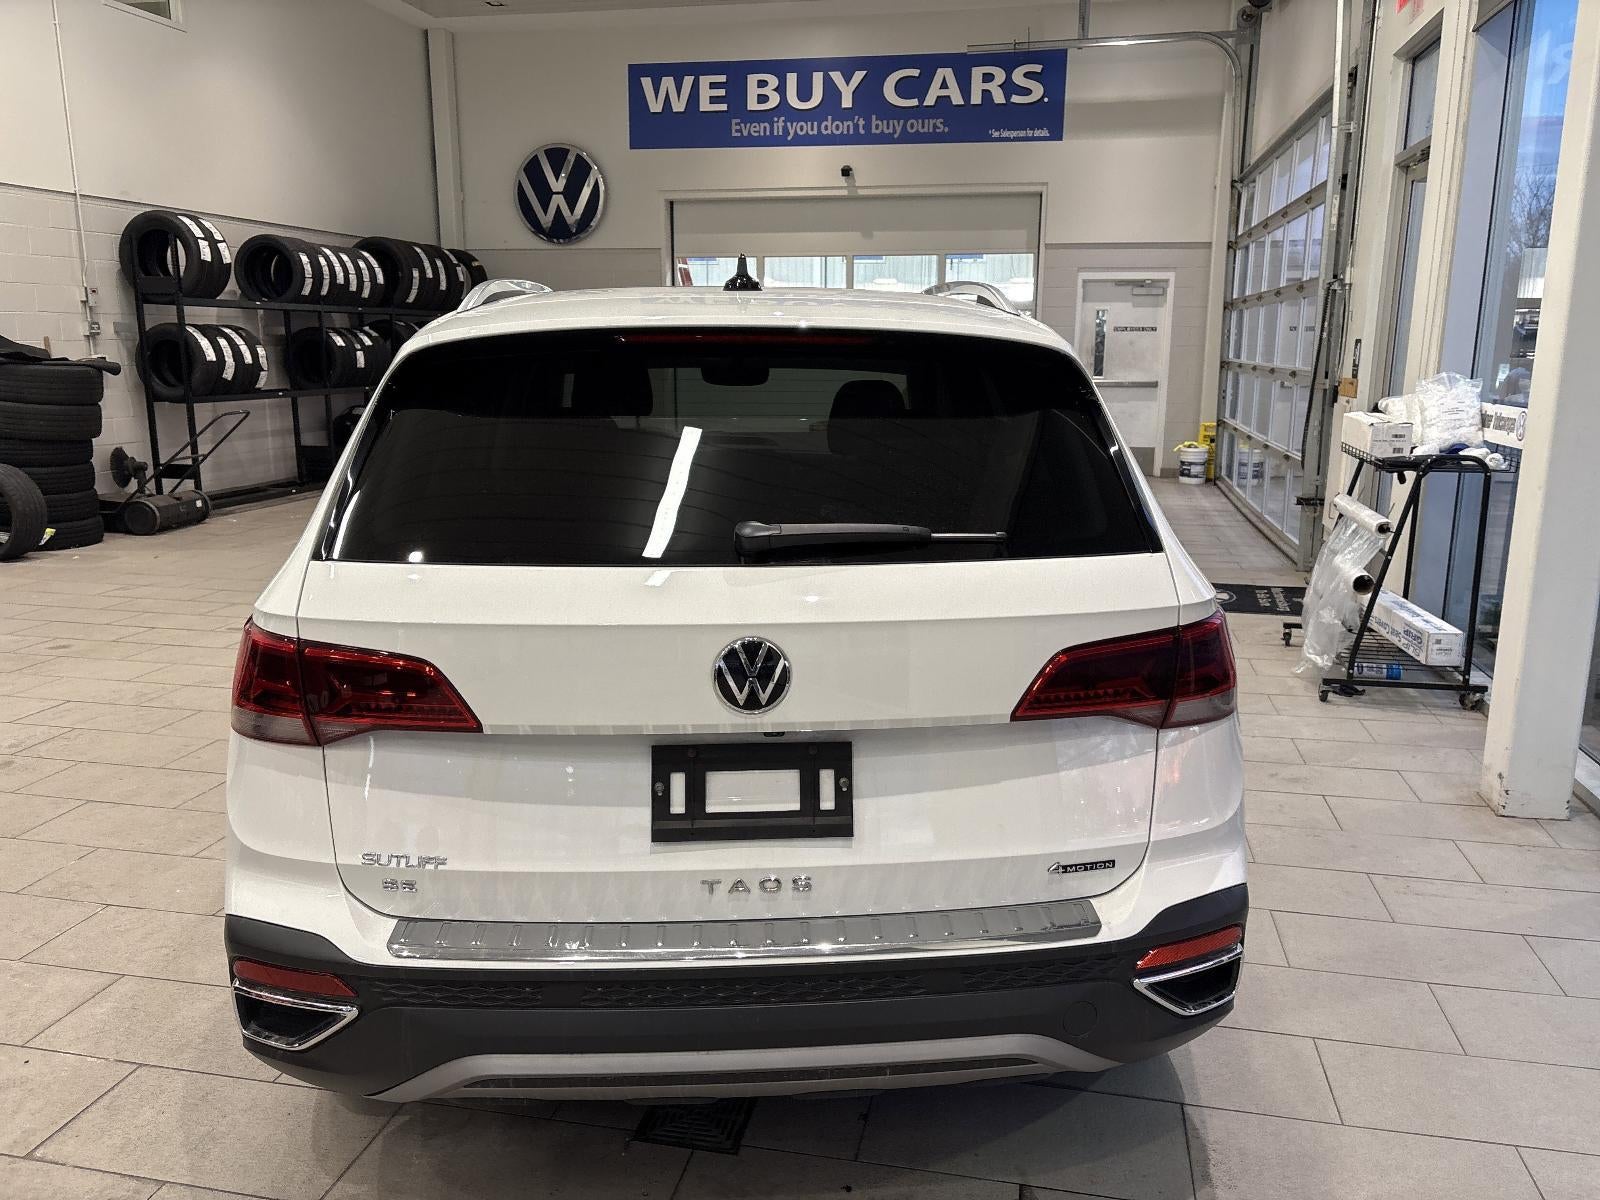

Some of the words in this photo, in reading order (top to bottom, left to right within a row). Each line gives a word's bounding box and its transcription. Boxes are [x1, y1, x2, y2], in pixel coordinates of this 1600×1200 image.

[640, 74, 729, 114] WE
[746, 70, 868, 111] BUY
[882, 63, 1049, 108] CARS.
[731, 118, 770, 137] Even
[773, 116, 786, 136] if
[787, 120, 818, 141] you
[821, 115, 866, 136] don't
[871, 114, 904, 139] buy
[906, 117, 949, 134] ours.
[1000, 127, 1026, 139] Salesperson
[1026, 127, 1034, 137] for
[361, 851, 448, 870] SUTLIFF
[382, 878, 418, 893] SE
[700, 875, 813, 896] TAOS
